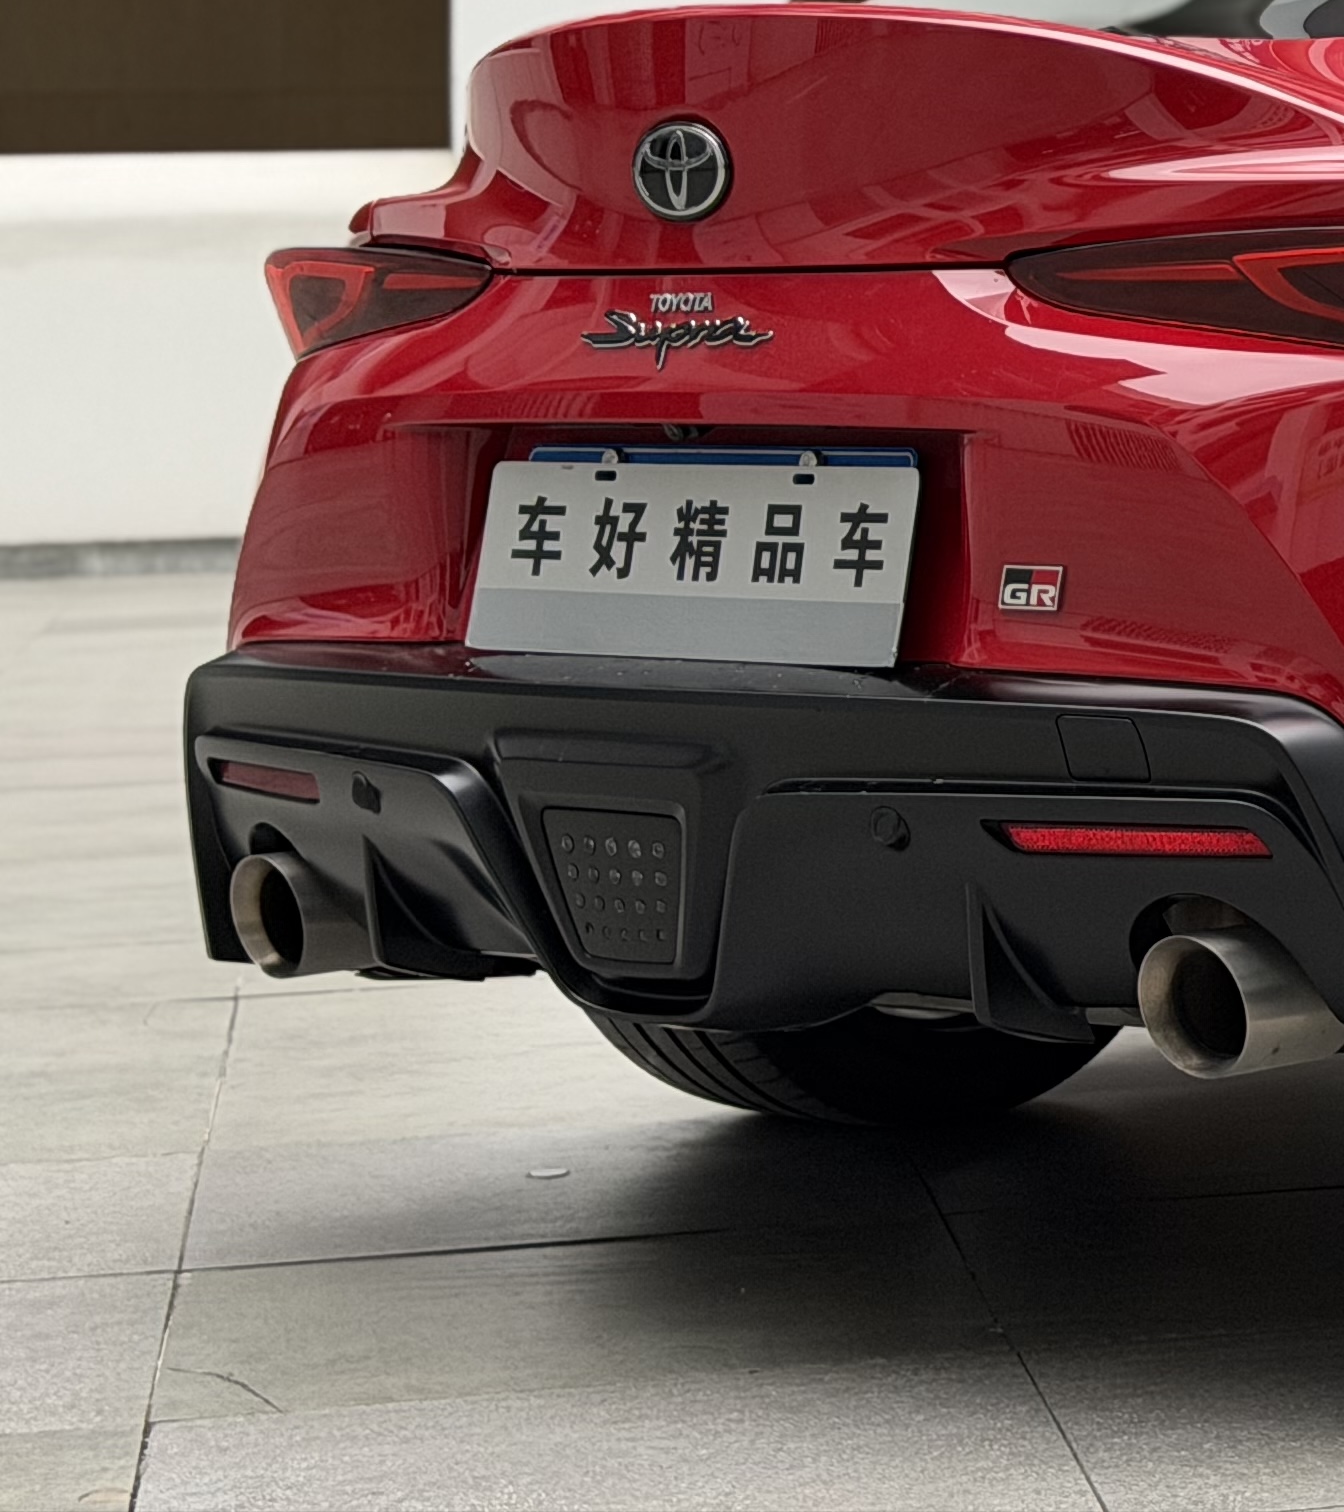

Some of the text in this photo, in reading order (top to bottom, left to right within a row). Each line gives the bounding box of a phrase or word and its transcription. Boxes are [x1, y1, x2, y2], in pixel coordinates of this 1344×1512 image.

[649, 291, 715, 314] TOYOTA
[579, 309, 774, 371] Supra
[510, 495, 890, 589] 车好精品车
[1003, 582, 1057, 608] GR
